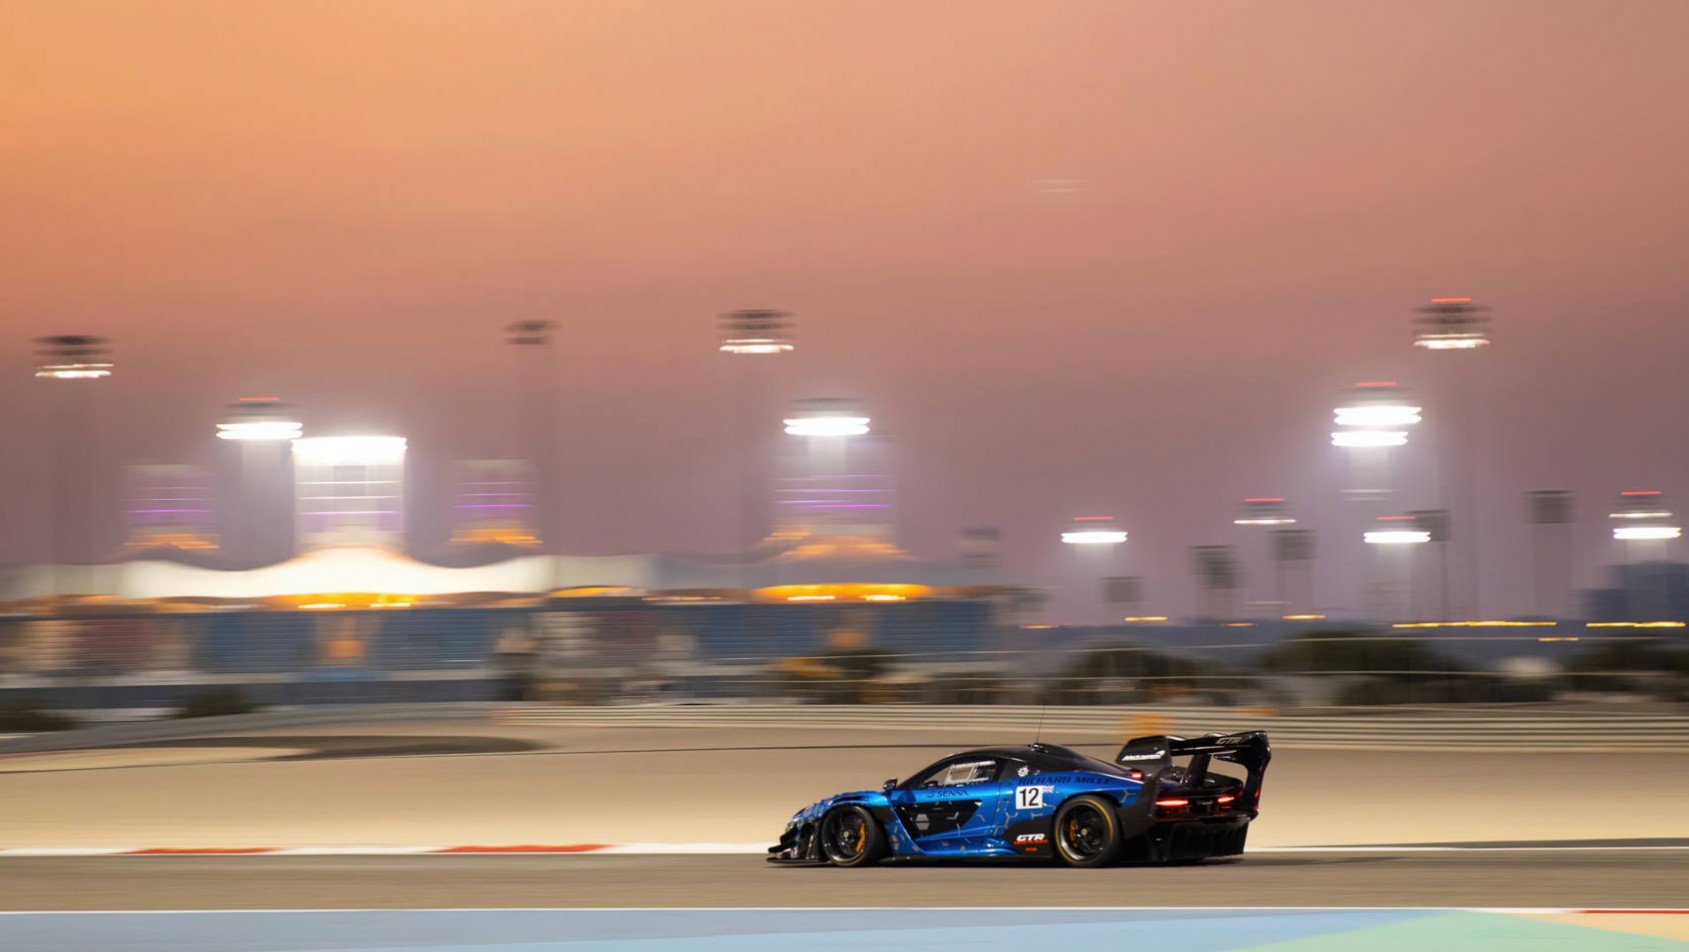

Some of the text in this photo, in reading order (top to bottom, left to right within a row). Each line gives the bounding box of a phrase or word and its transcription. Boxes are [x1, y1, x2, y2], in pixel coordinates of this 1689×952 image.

[1019, 776, 1072, 786] RICHARD
[937, 789, 969, 798] SENNA
[1019, 788, 1039, 806] 12
[1016, 833, 1045, 842] GTR
